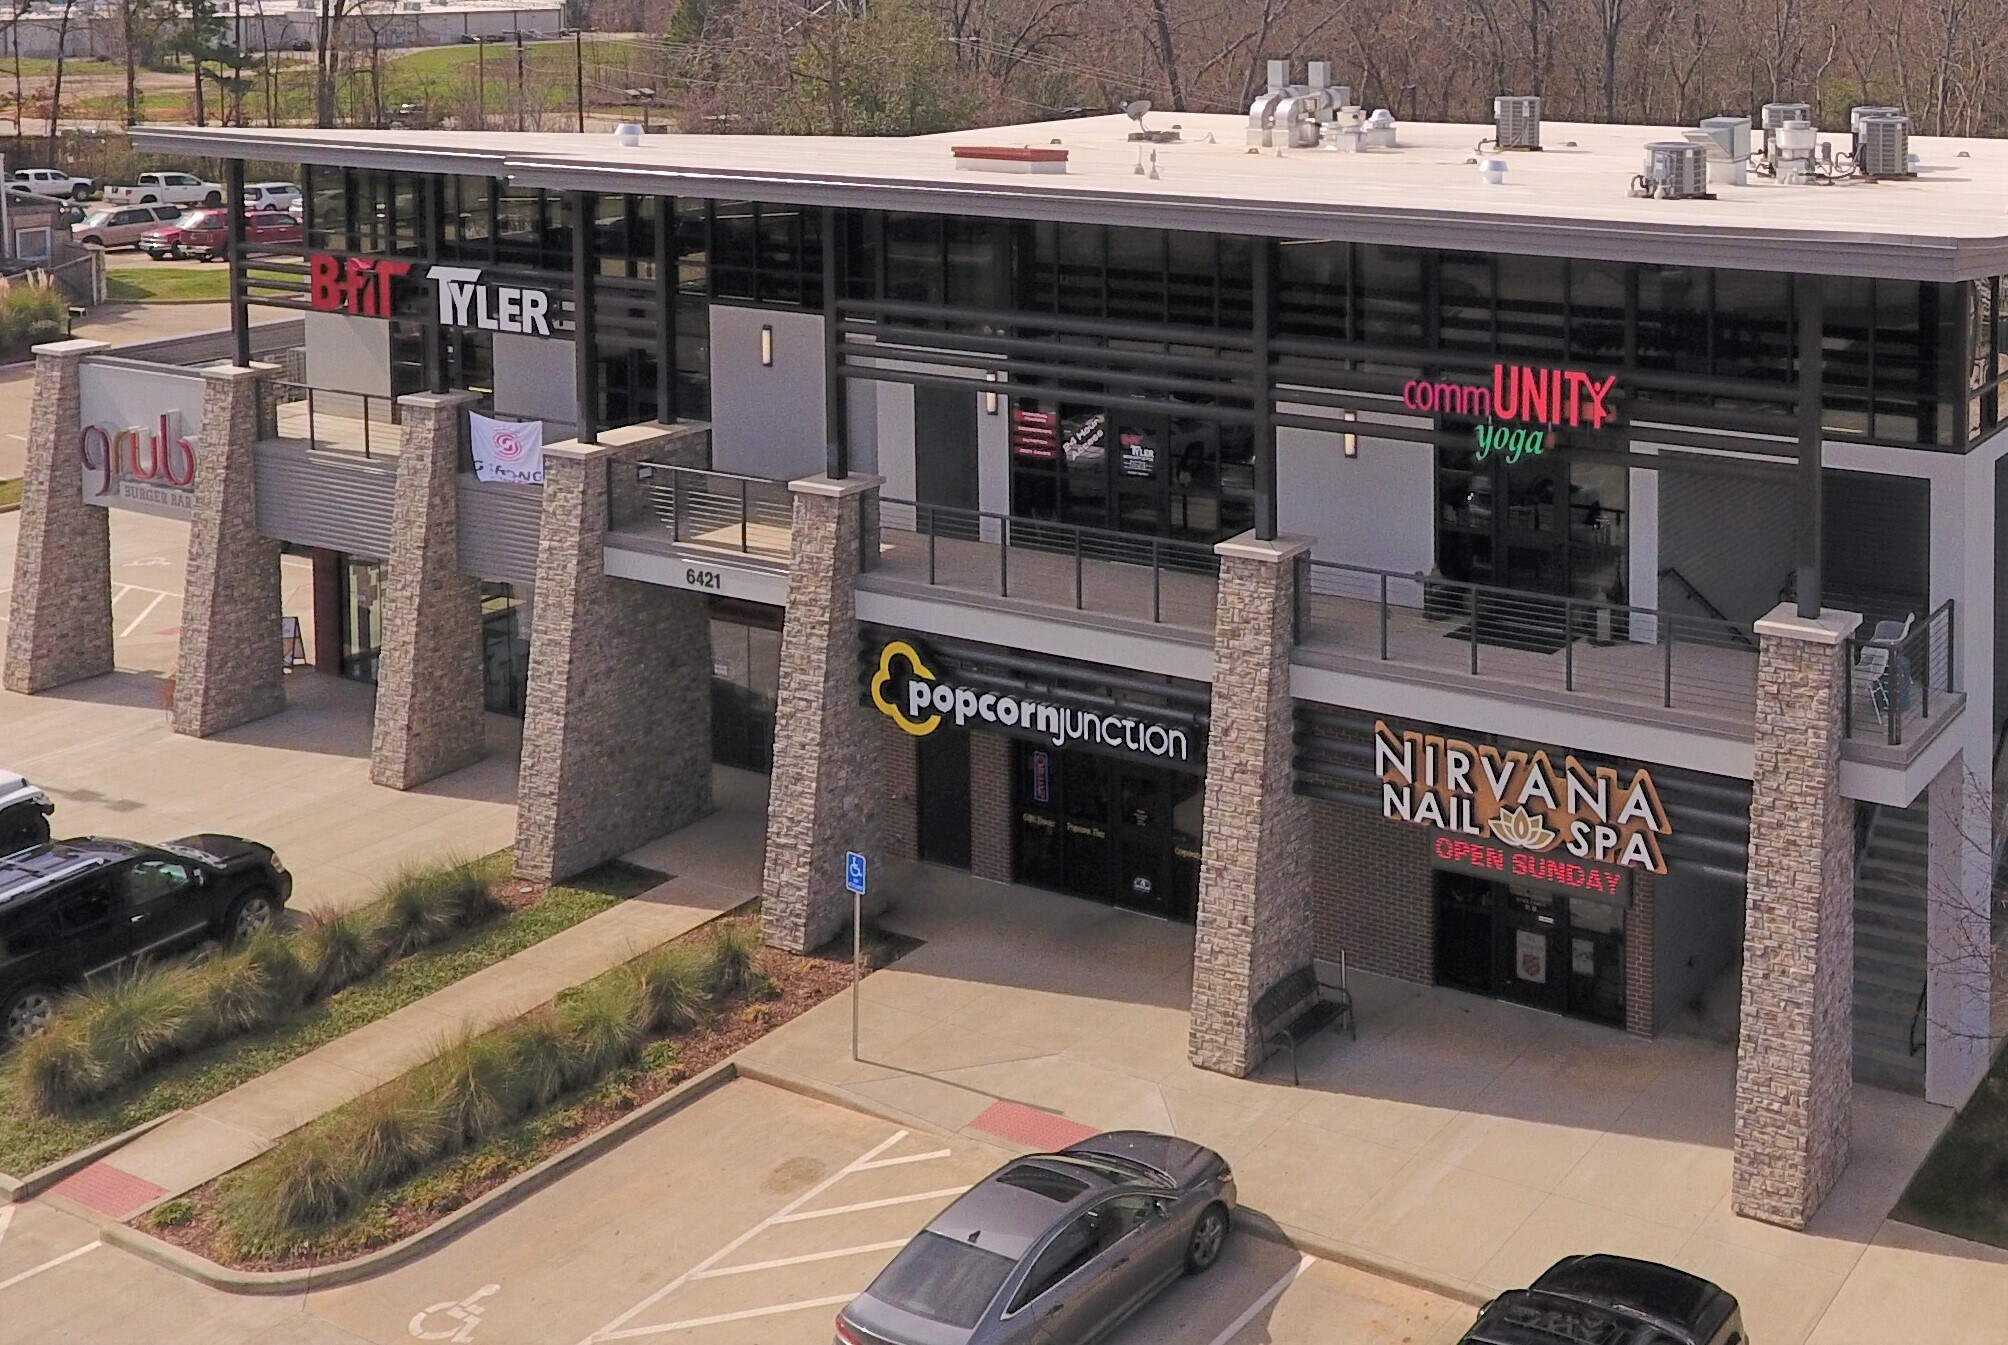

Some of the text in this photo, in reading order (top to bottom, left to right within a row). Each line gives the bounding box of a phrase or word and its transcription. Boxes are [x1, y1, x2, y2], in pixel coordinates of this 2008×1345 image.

[426, 265, 551, 336] TYLER
[1403, 364, 1617, 430] commUNITY
[81, 410, 196, 497] grub
[1475, 424, 1545, 464] yoga
[124, 485, 193, 509] BURGER BAR
[686, 568, 721, 589] 6421
[1375, 733, 1660, 833] NIRVANA
[1383, 783, 1656, 872] NAIL SPA
[1435, 837, 1621, 895] OPEN SUNDAY
